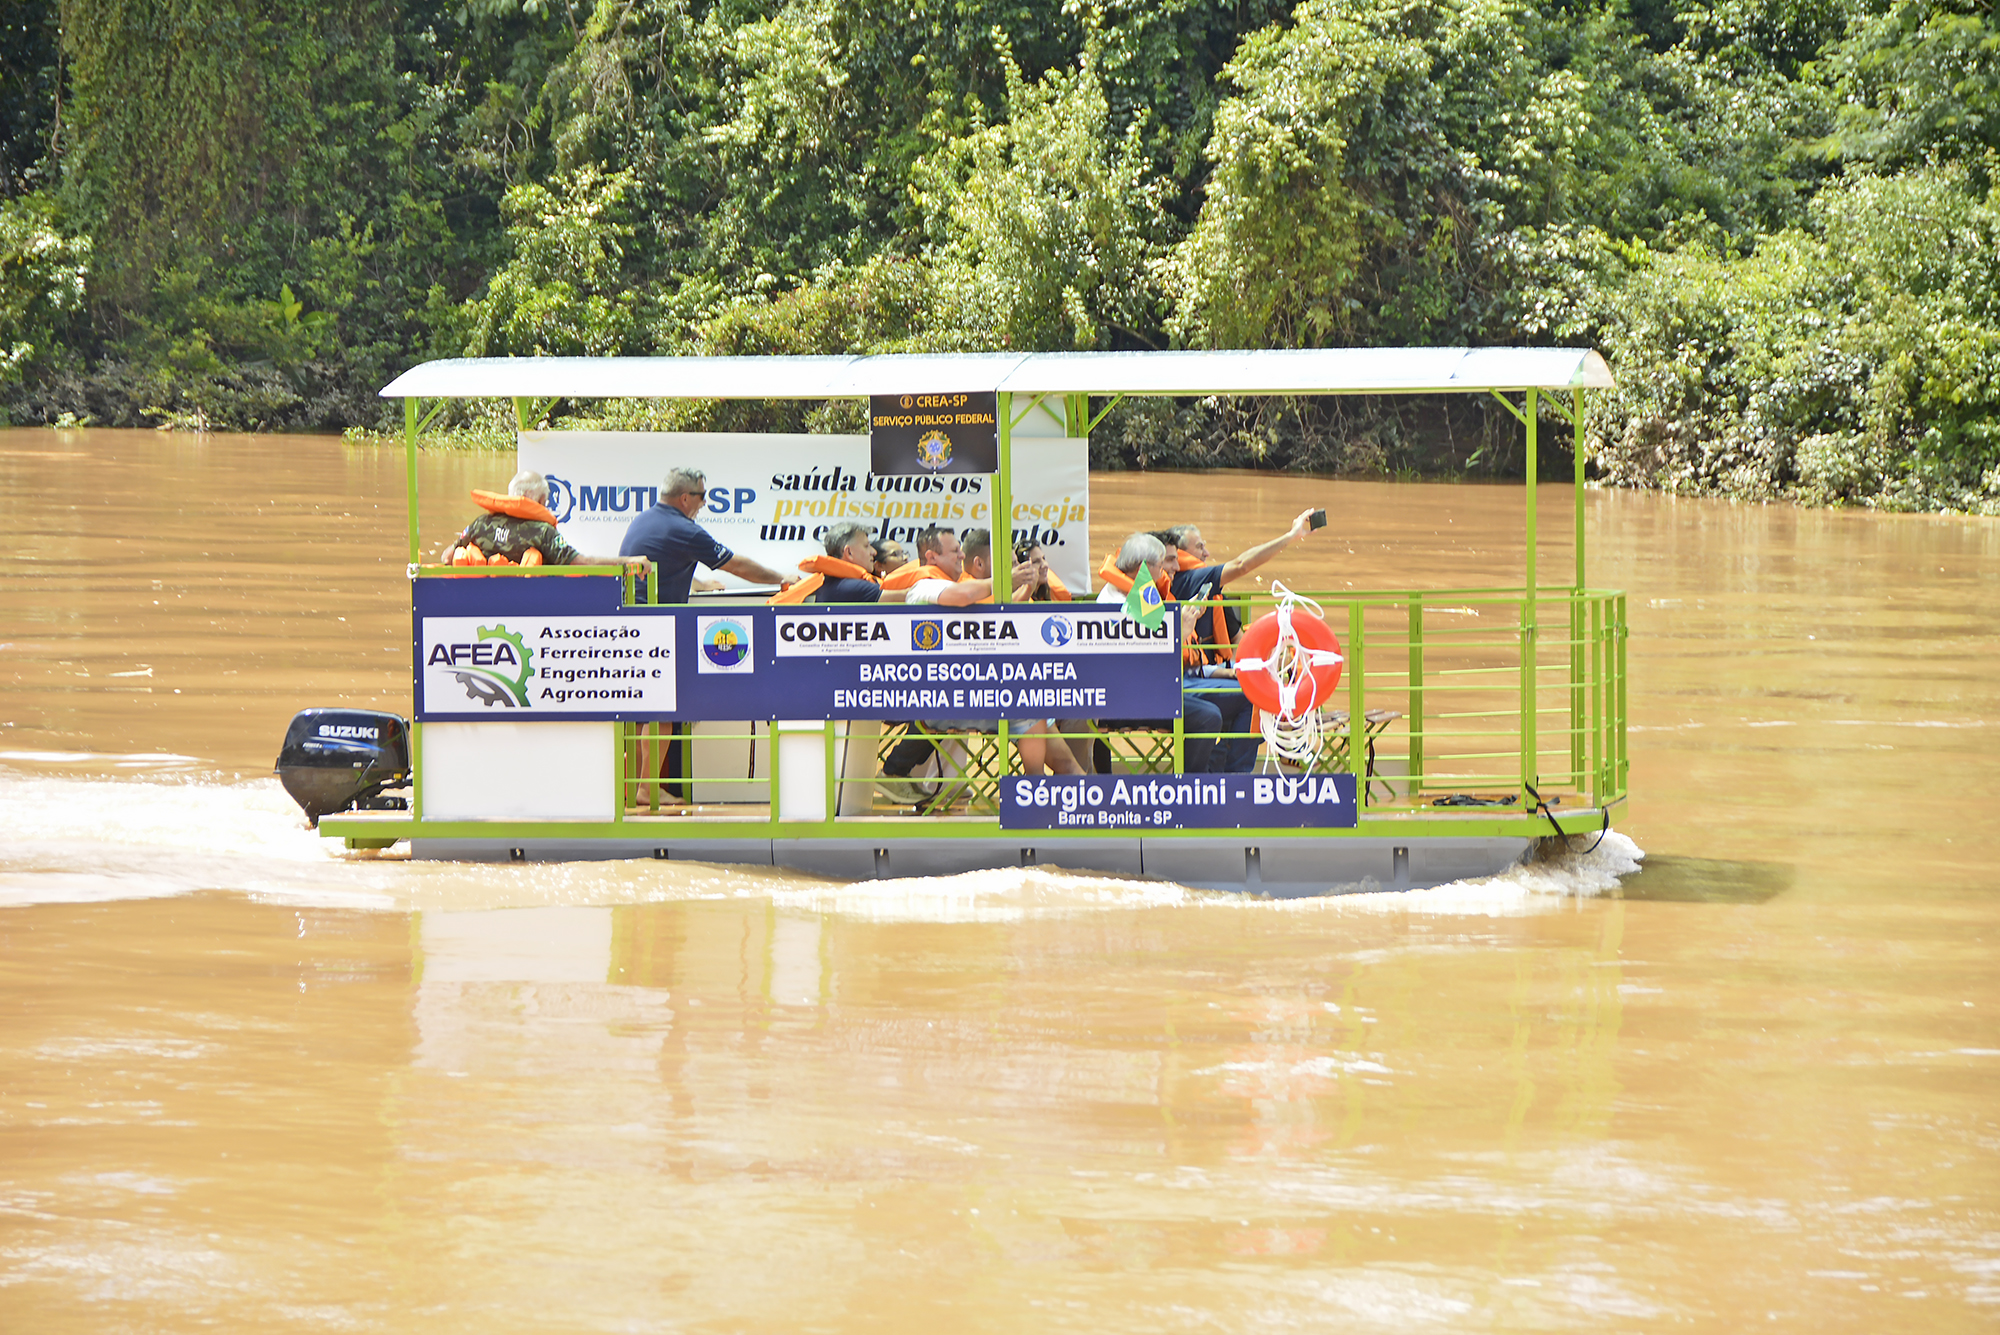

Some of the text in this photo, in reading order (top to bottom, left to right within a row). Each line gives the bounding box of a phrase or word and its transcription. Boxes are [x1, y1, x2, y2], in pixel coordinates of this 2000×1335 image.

[916, 394, 968, 408] CREA-SP
[873, 413, 995, 428] SERVIÇO PÚBLICO FEDERAL
[769, 466, 858, 491] saúda
[950, 476, 982, 494] os
[773, 490, 1087, 528] profissionais e eseja
[494, 527, 510, 543] RUI
[759, 524, 806, 541] um
[539, 625, 641, 642] Associação
[780, 621, 891, 642] CONFEA
[946, 620, 1019, 641] CREA
[427, 643, 517, 666] AFEA
[540, 646, 671, 659] Ferreirense de
[540, 666, 661, 682] Engenharia e
[859, 662, 1078, 682] BARCO ESCOLA DA AFEA
[540, 687, 644, 703] Agronomia
[834, 688, 1107, 708] ENGENHARIA E MEIO AMBIENTE
[319, 724, 379, 739] SUZUKI
[1015, 779, 1104, 812] Sérgio
[1110, 778, 1226, 806] Antonini
[1253, 777, 1341, 805] BUJA
[1058, 810, 1094, 825] Barra
[1098, 810, 1141, 825] Bonita
[1153, 810, 1172, 825] SP
